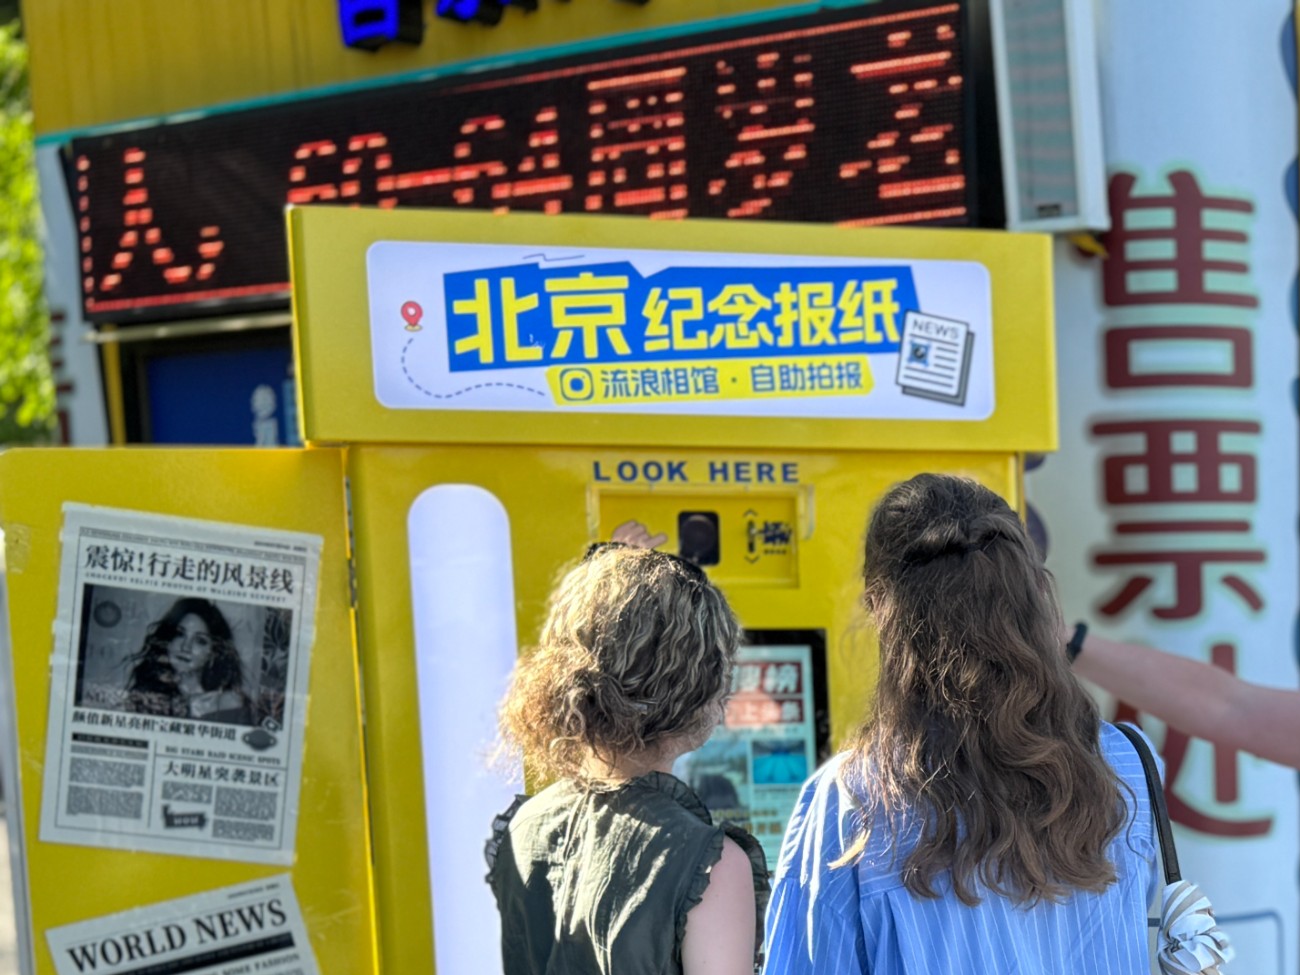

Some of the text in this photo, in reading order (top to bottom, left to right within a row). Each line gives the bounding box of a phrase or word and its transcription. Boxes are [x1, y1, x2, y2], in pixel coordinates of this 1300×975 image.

[452, 273, 901, 365] 北京纪念报纸
[912, 318, 959, 339] NEWS
[592, 461, 799, 483] LOOK HERE
[66, 924, 187, 974] WORLD
[192, 899, 287, 944] NEWS
[254, 954, 300, 971] FASHION
